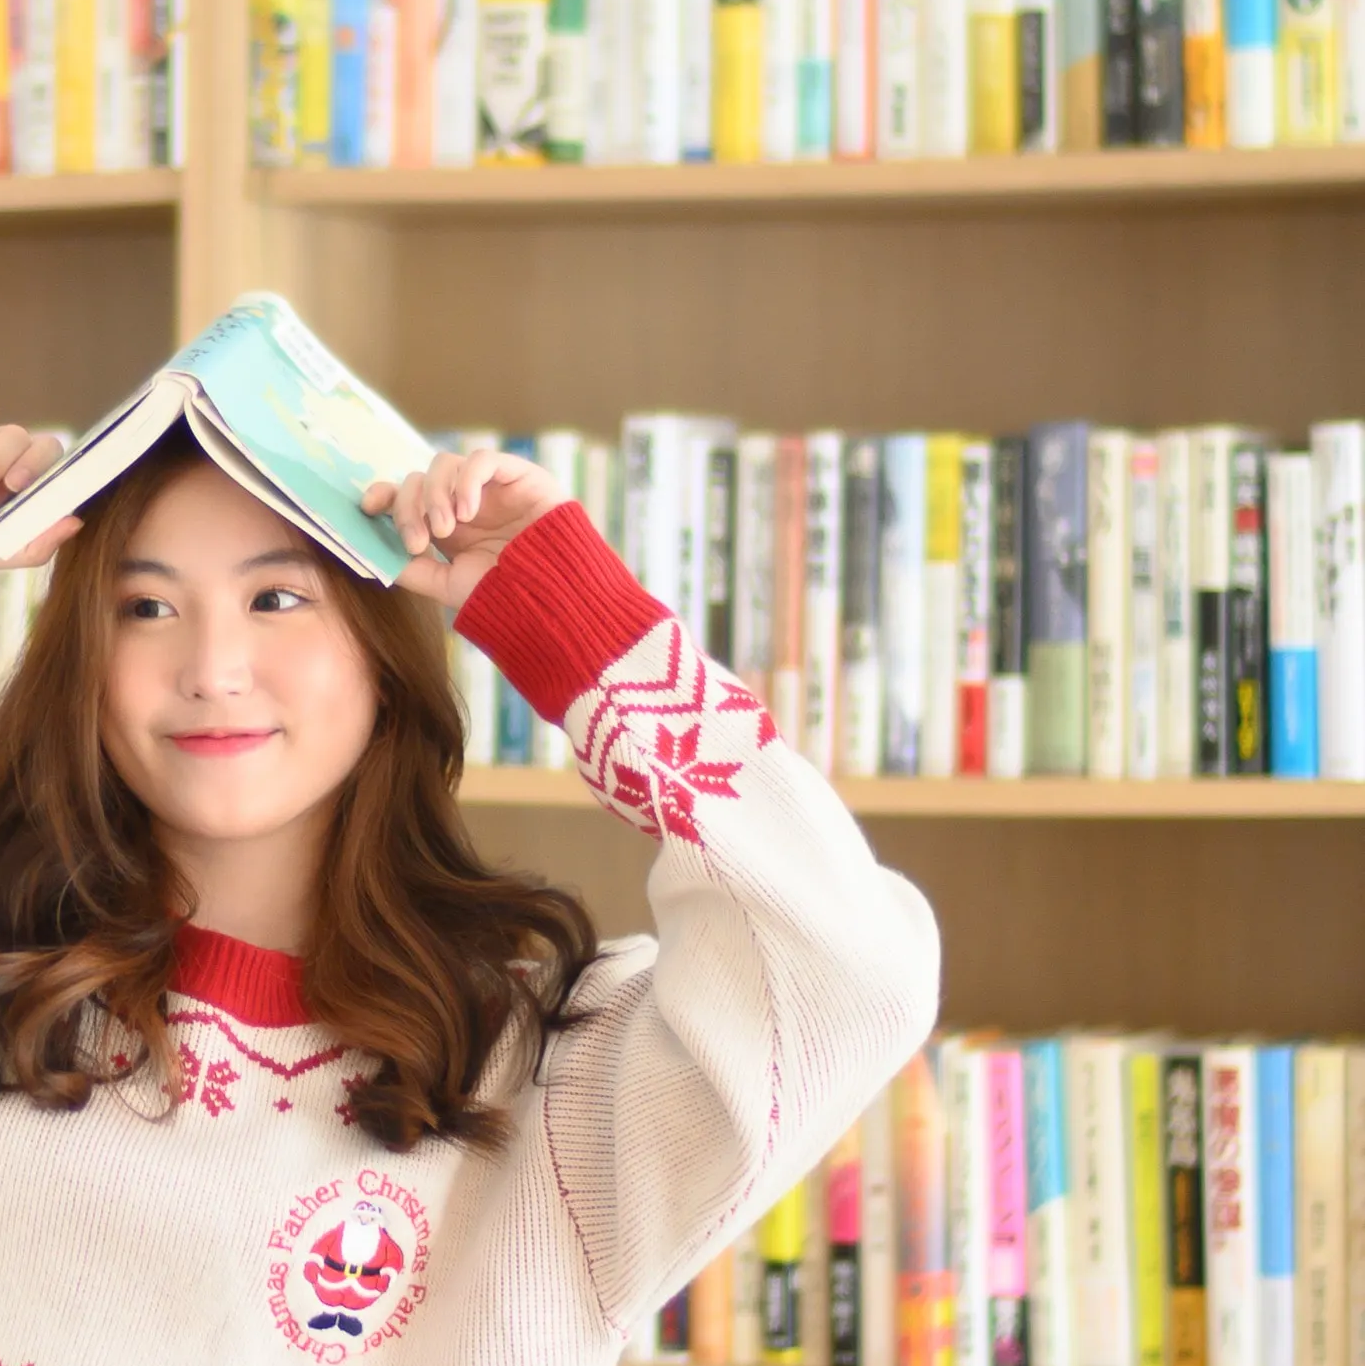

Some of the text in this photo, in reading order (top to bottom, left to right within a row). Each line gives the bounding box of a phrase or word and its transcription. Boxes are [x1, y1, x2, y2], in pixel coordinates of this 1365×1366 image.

[266, 1168, 432, 1275] Father Christmas
[266, 1262, 427, 1366] Father Christmas
